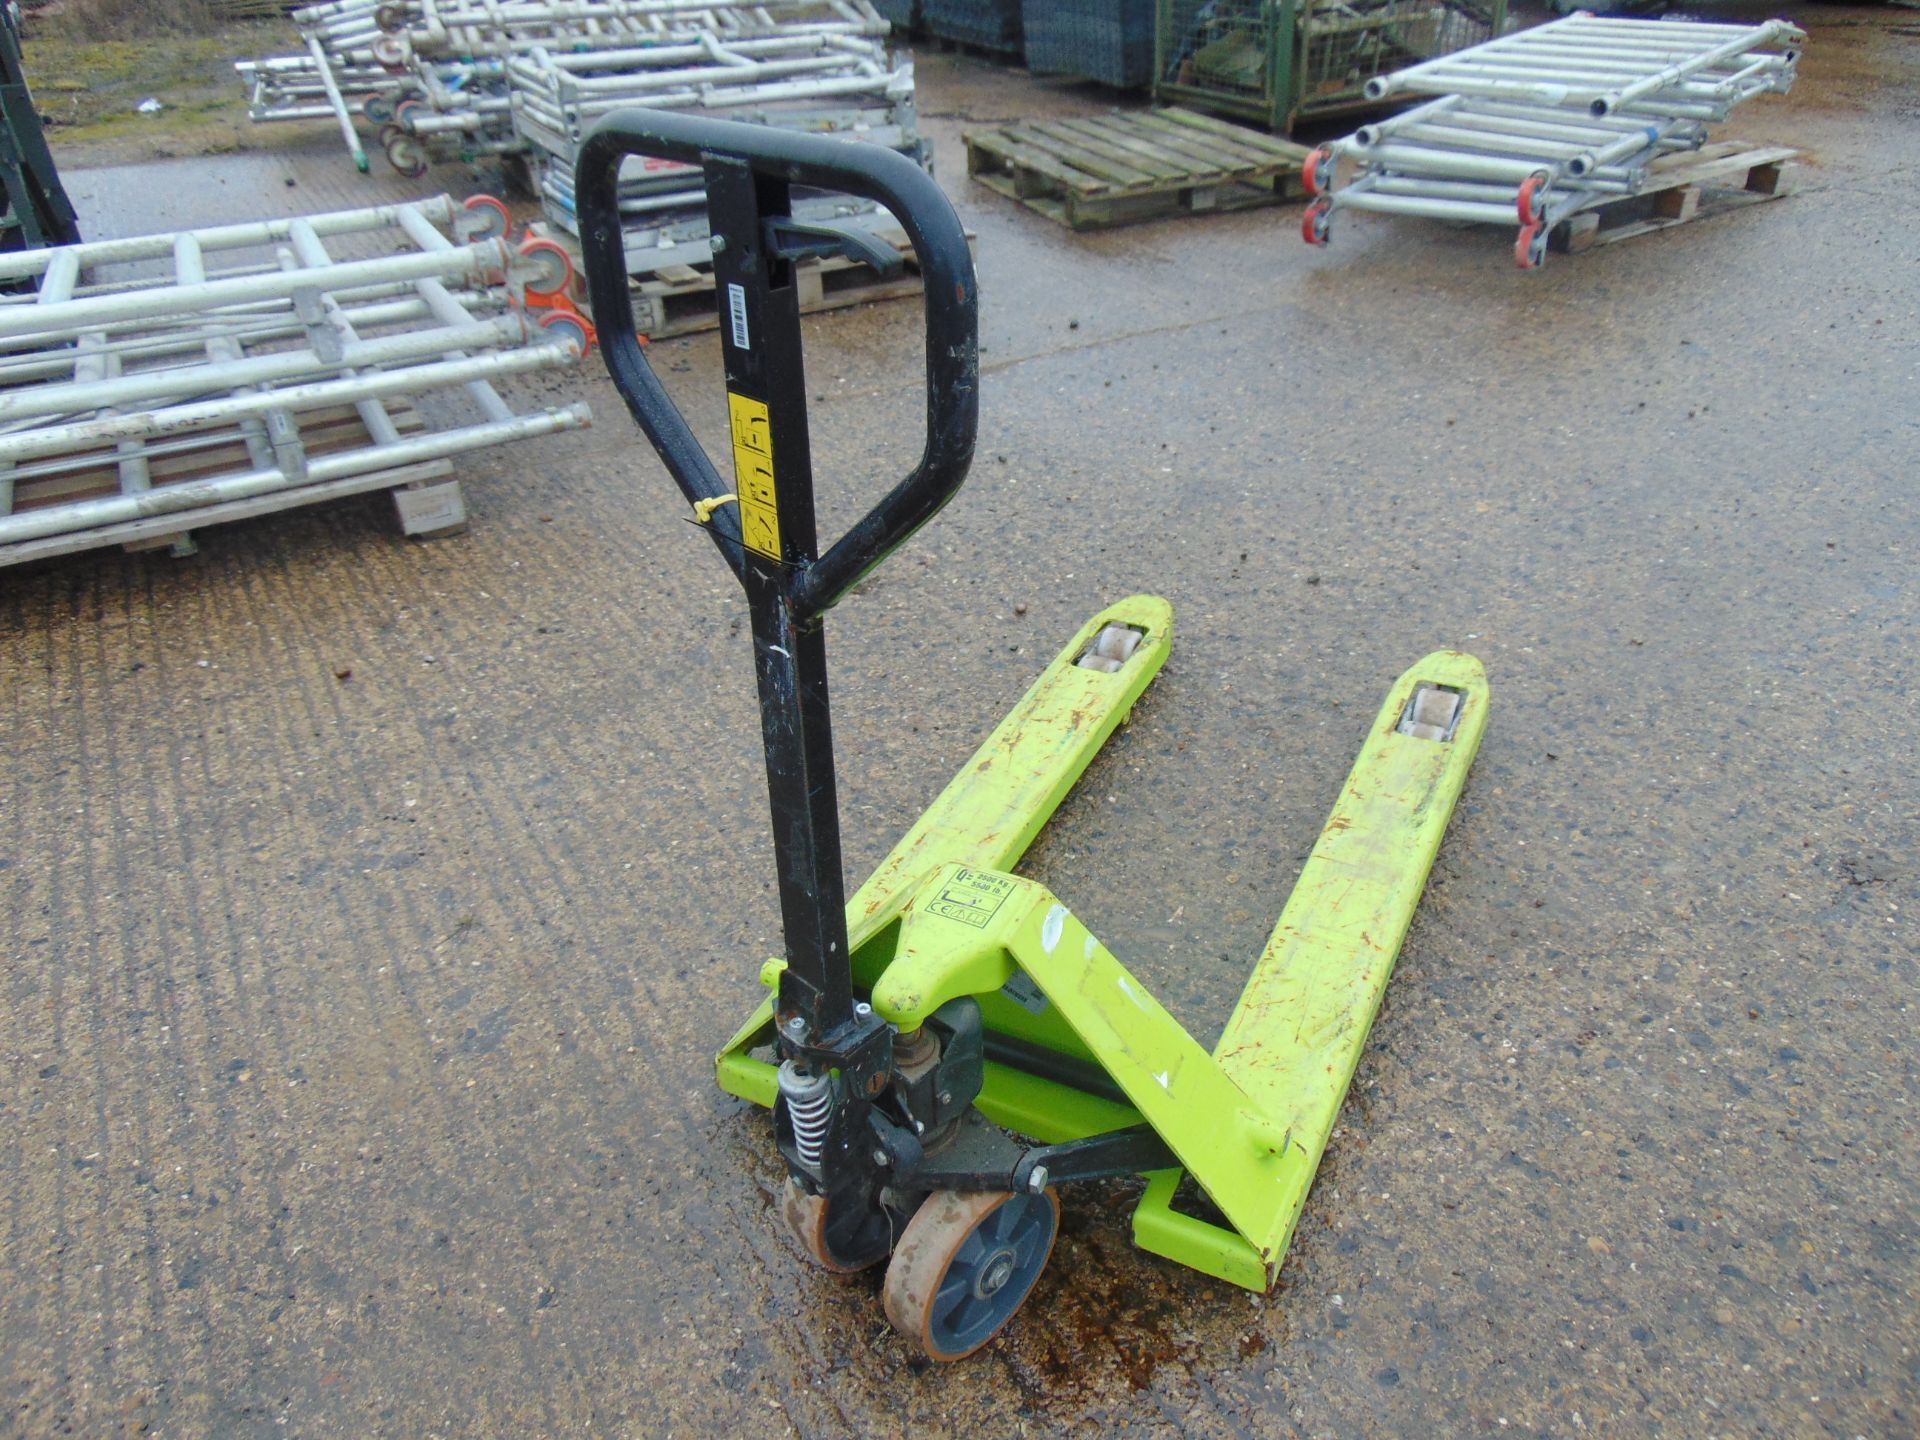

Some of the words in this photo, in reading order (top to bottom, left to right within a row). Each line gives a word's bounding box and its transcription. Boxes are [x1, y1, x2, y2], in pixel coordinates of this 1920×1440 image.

[771, 515, 777, 526] 2
[977, 873, 998, 884] 2500
[970, 881, 991, 891] 5500
